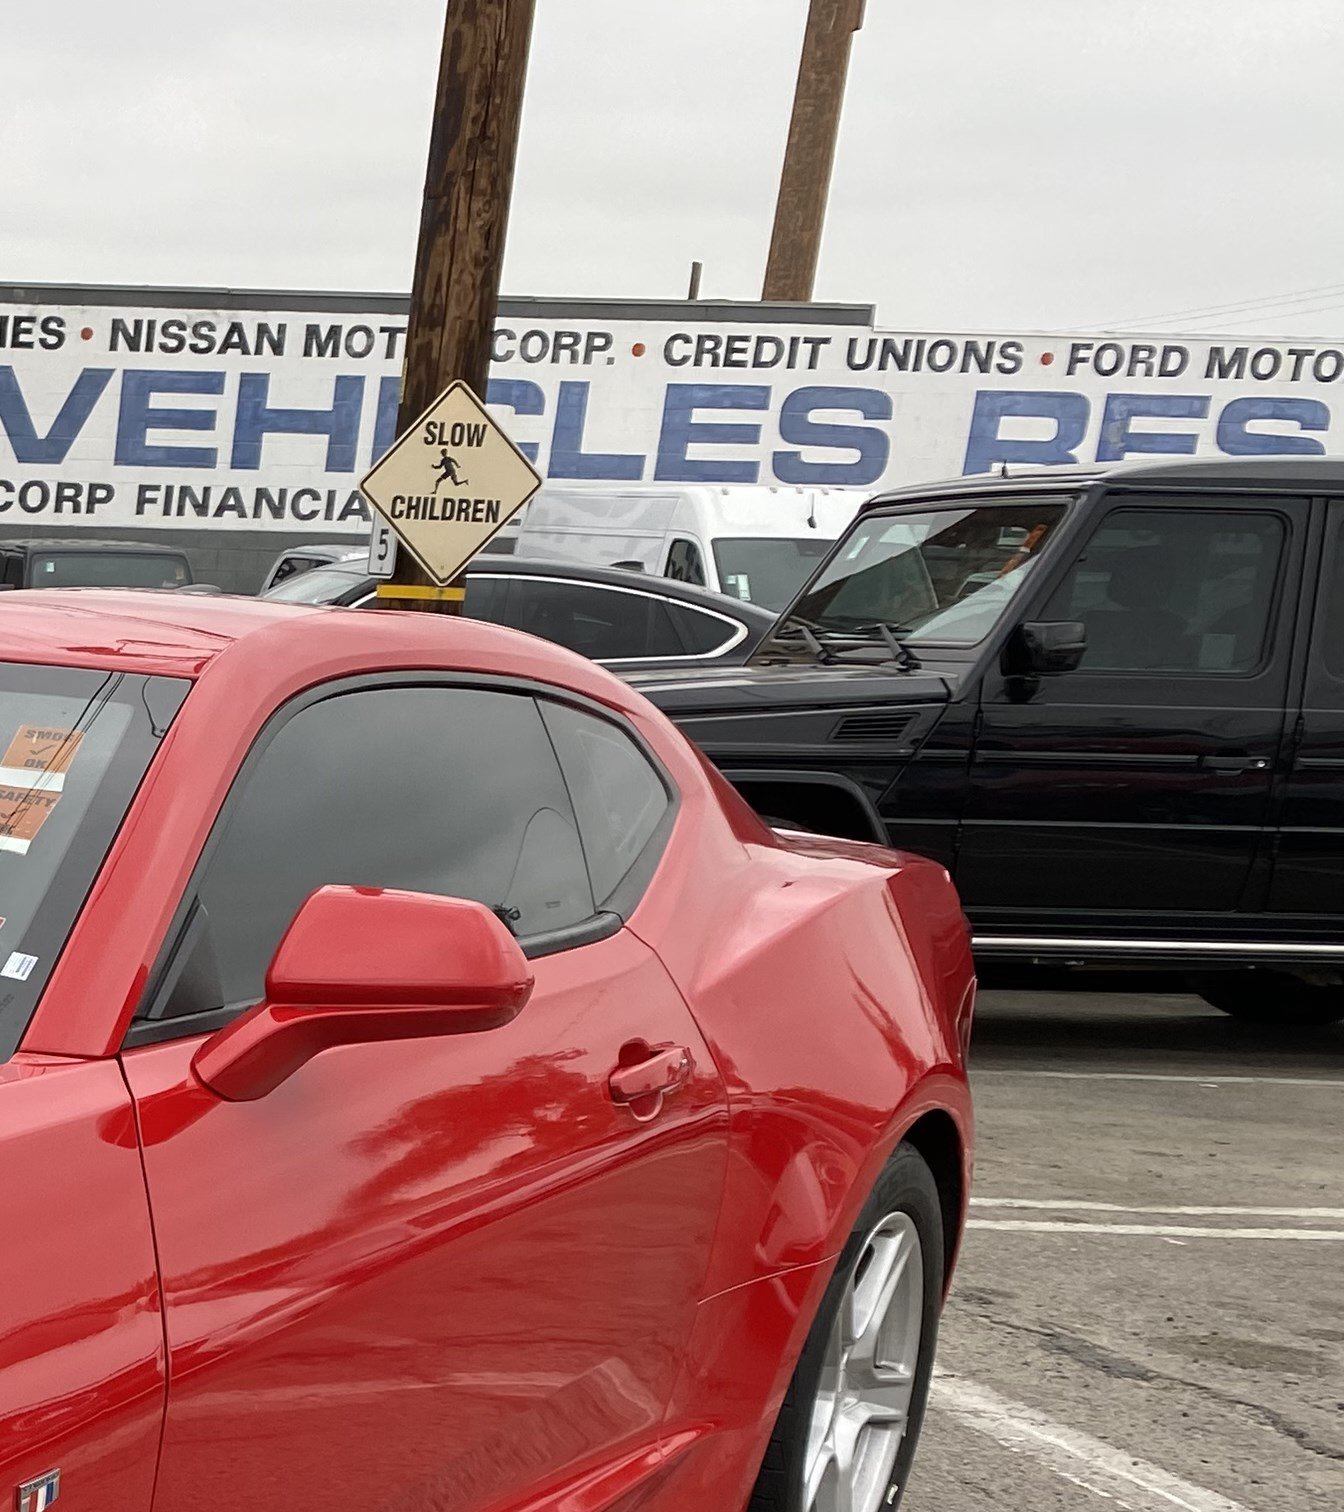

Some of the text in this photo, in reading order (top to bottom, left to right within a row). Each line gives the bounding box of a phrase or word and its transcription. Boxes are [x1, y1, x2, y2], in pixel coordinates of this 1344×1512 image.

[109, 318, 287, 357] NISSAN
[303, 324, 407, 359] MOT
[490, 329, 615, 365] CORP.
[663, 332, 830, 370] CREDIT
[846, 337, 1024, 374] UNIONS
[1065, 341, 1188, 379] FORD
[424, 420, 488, 448] SLOW
[135, 483, 373, 523] FINANCIA
[390, 495, 501, 524] CHILDREN
[23, 758, 48, 769] OK
